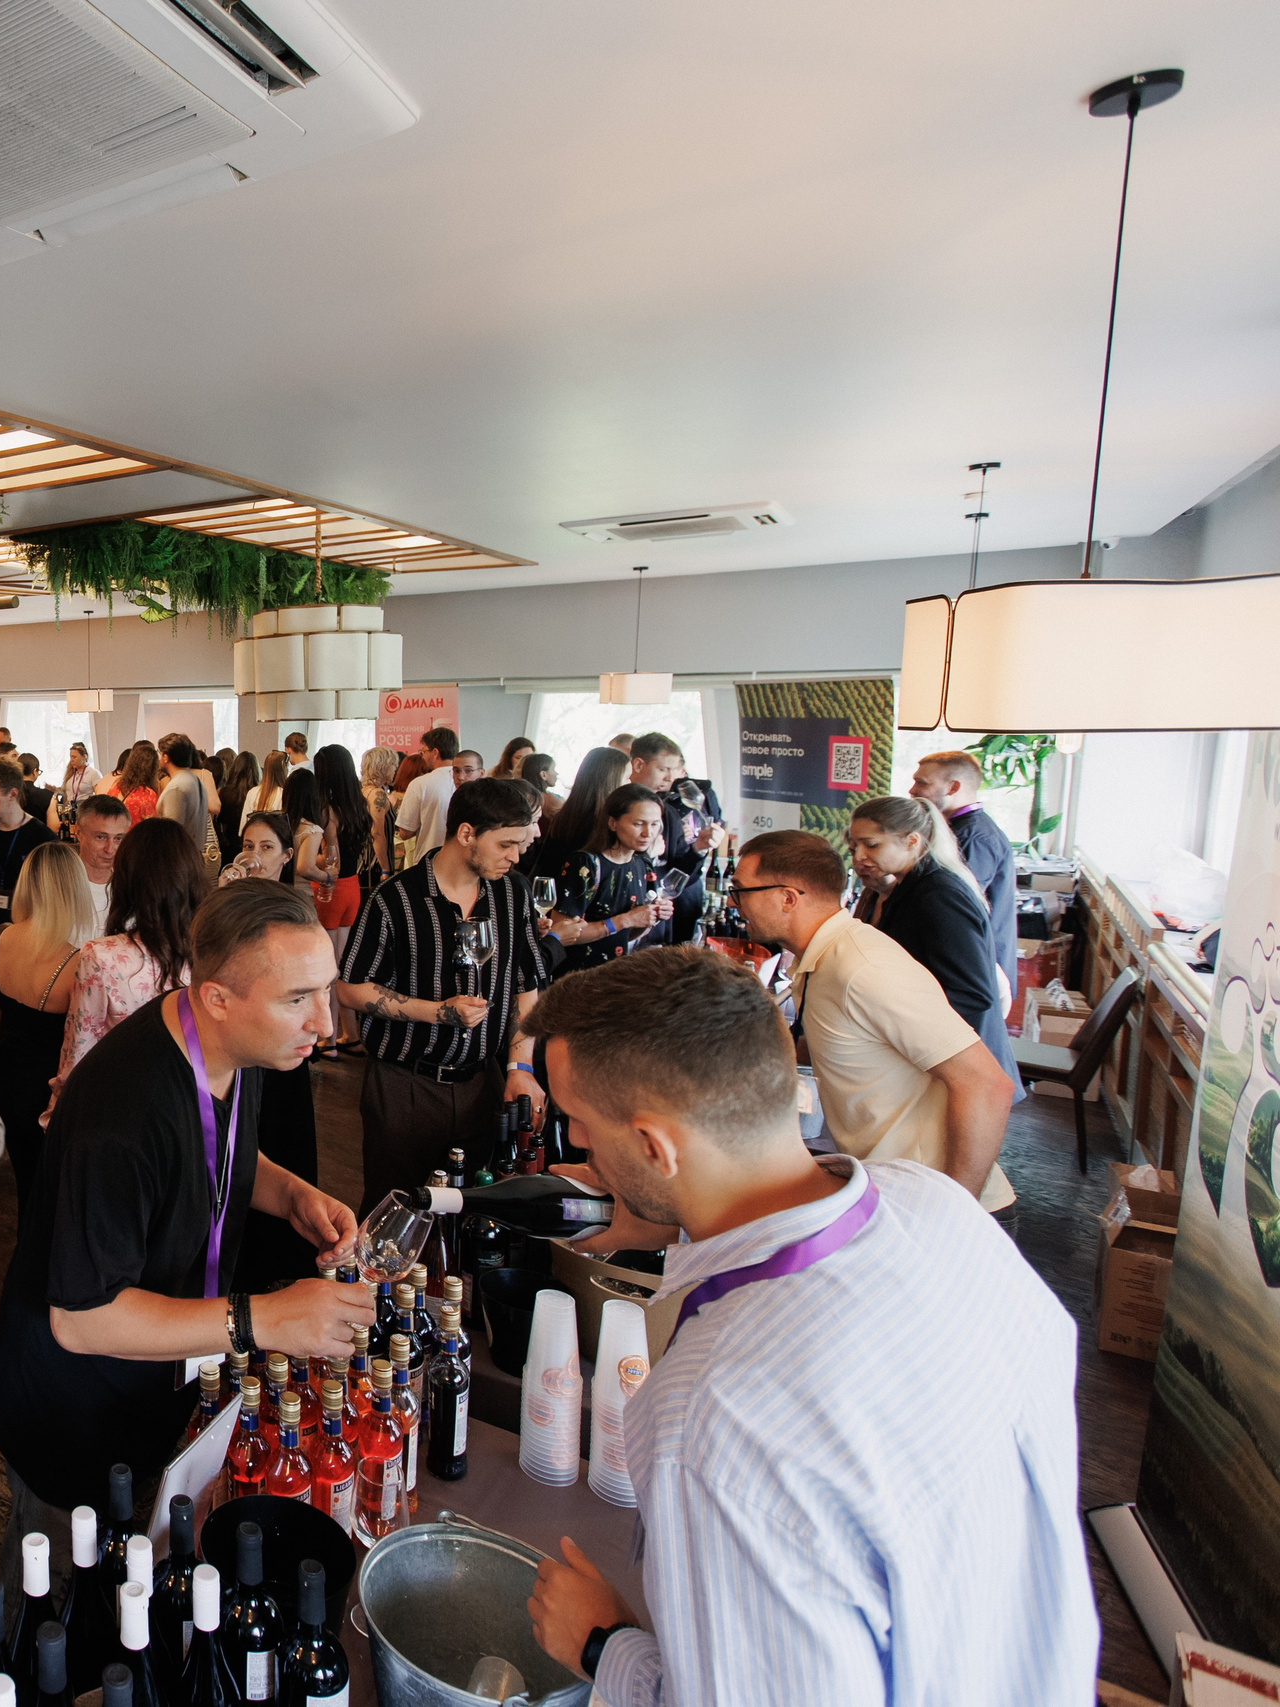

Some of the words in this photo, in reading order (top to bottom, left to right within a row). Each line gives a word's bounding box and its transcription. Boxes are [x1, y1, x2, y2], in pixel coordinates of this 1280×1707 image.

[404, 698, 444, 709] ДИЛАН
[380, 725, 424, 733] НАСТРОЕНИЯ
[380, 734, 411, 746] РОЗЕ
[742, 731, 792, 743] Открывать
[742, 746, 769, 755] новое
[771, 747, 804, 757] просто
[741, 763, 773, 779] simple
[753, 815, 773, 828] 450
